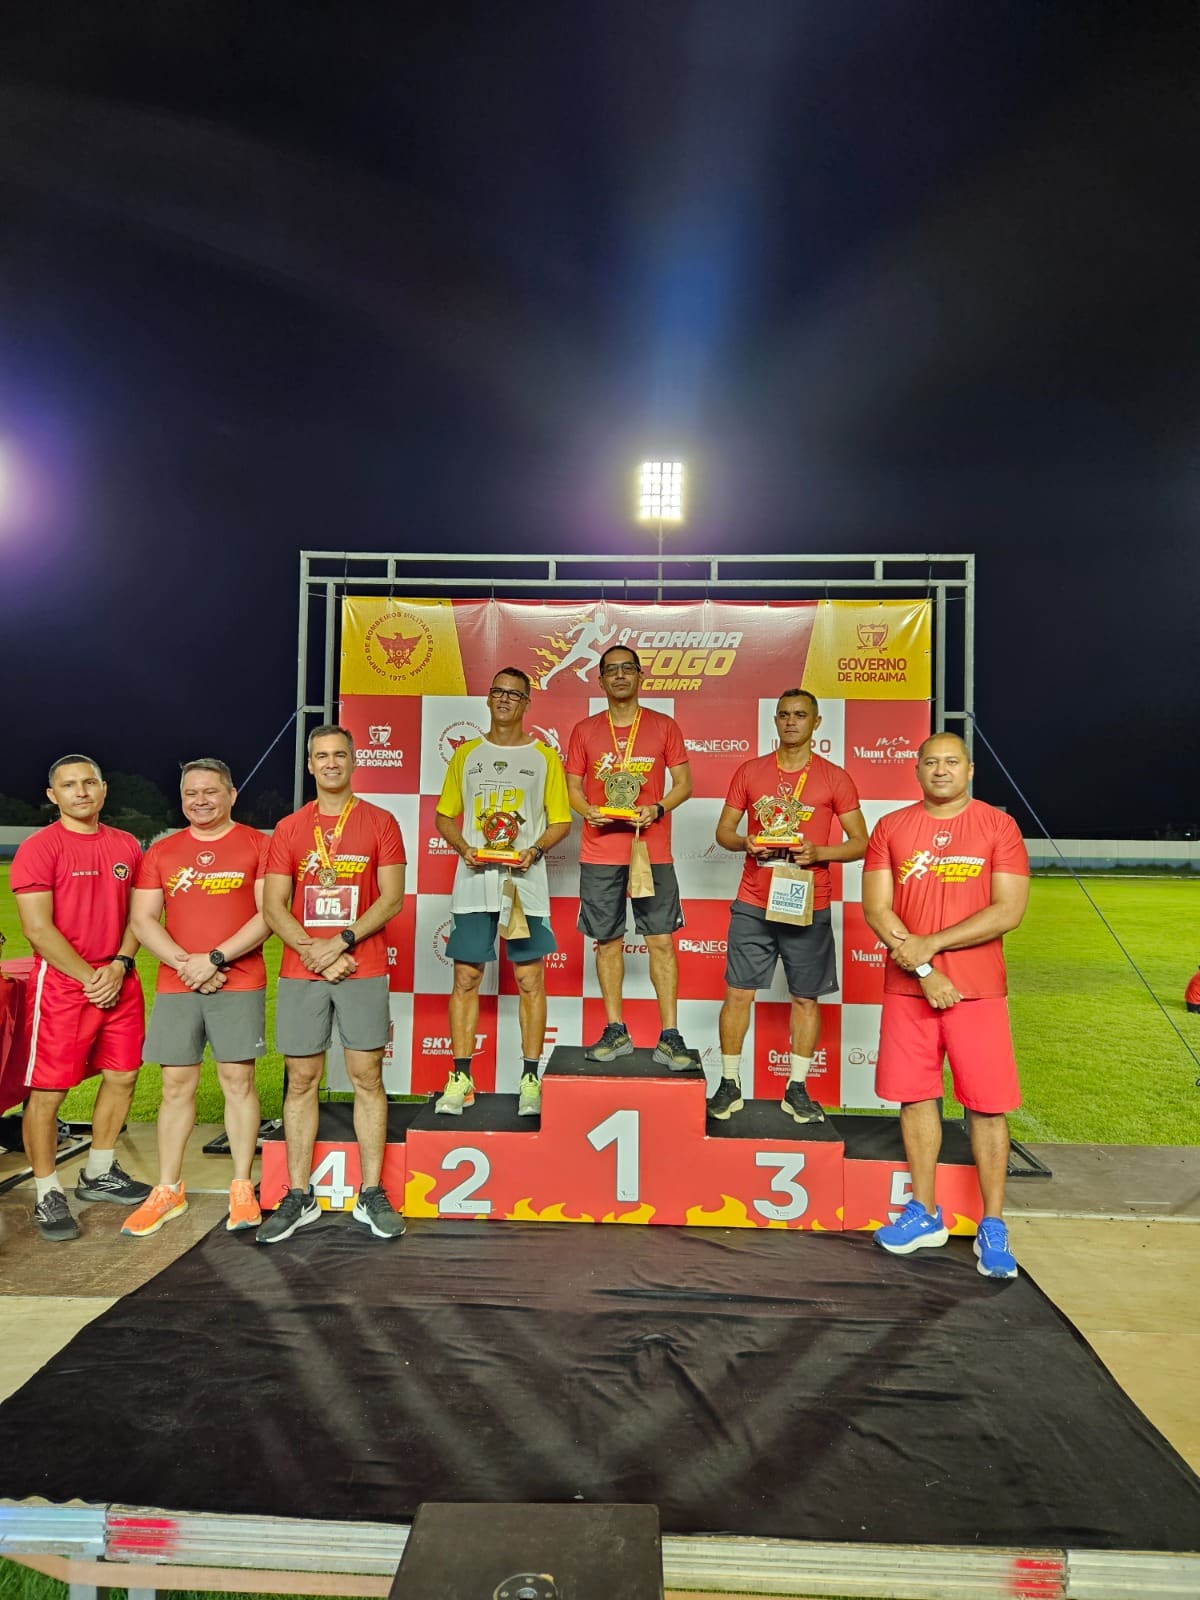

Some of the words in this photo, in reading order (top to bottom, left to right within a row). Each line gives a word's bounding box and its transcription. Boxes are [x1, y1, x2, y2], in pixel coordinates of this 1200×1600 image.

[366, 612, 402, 640] BOMBEIROS
[404, 612, 430, 634] MILITAR
[637, 632, 744, 648] CORRIDA
[636, 650, 736, 676] FOGO
[838, 658, 907, 670] GOVERNO
[838, 672, 852, 682] DE
[854, 672, 907, 682] RORAIMA
[641, 678, 702, 690] CBMRR
[355, 749, 404, 760] GOVERNO
[853, 746, 884, 758] Manu
[366, 760, 403, 768] RORAIMA
[628, 762, 654, 772] OGO
[940, 856, 986, 866] CORRIDA
[205, 872, 246, 880] CORRIDA
[936, 864, 982, 877] FOGO
[202, 878, 244, 890] FOGO
[316, 898, 340, 915] 075
[852, 950, 883, 962] Manu
[586, 1110, 640, 1202] 1
[308, 1150, 354, 1208] 4
[438, 1146, 492, 1214] 2
[752, 1152, 809, 1221] 3
